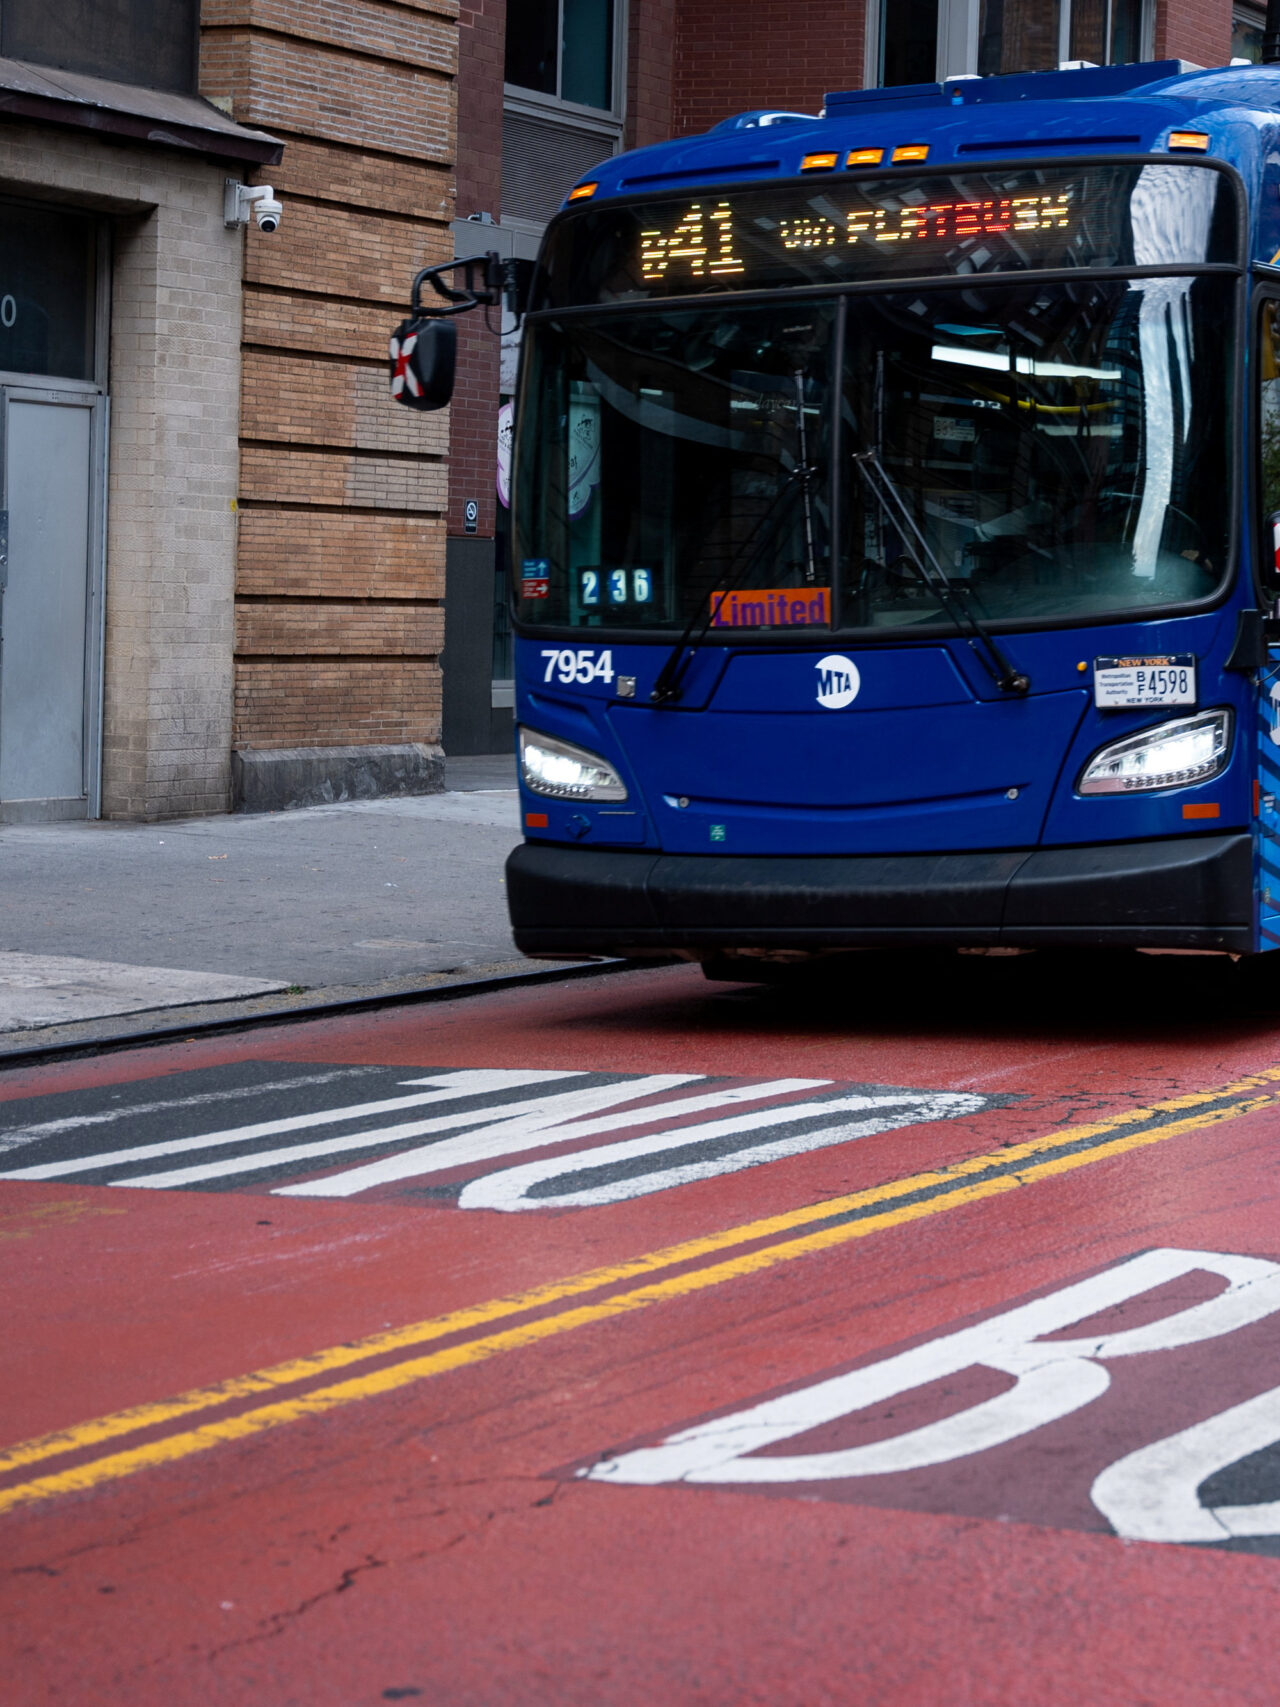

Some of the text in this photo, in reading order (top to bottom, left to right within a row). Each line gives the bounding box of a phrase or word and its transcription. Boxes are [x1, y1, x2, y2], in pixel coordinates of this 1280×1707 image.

[641, 203, 745, 279] B41
[713, 591, 825, 627] Limited
[540, 649, 614, 684] 7954
[1118, 657, 1170, 667] NEW YORK
[815, 664, 855, 700] MTA
[1148, 669, 1188, 695] 4598
